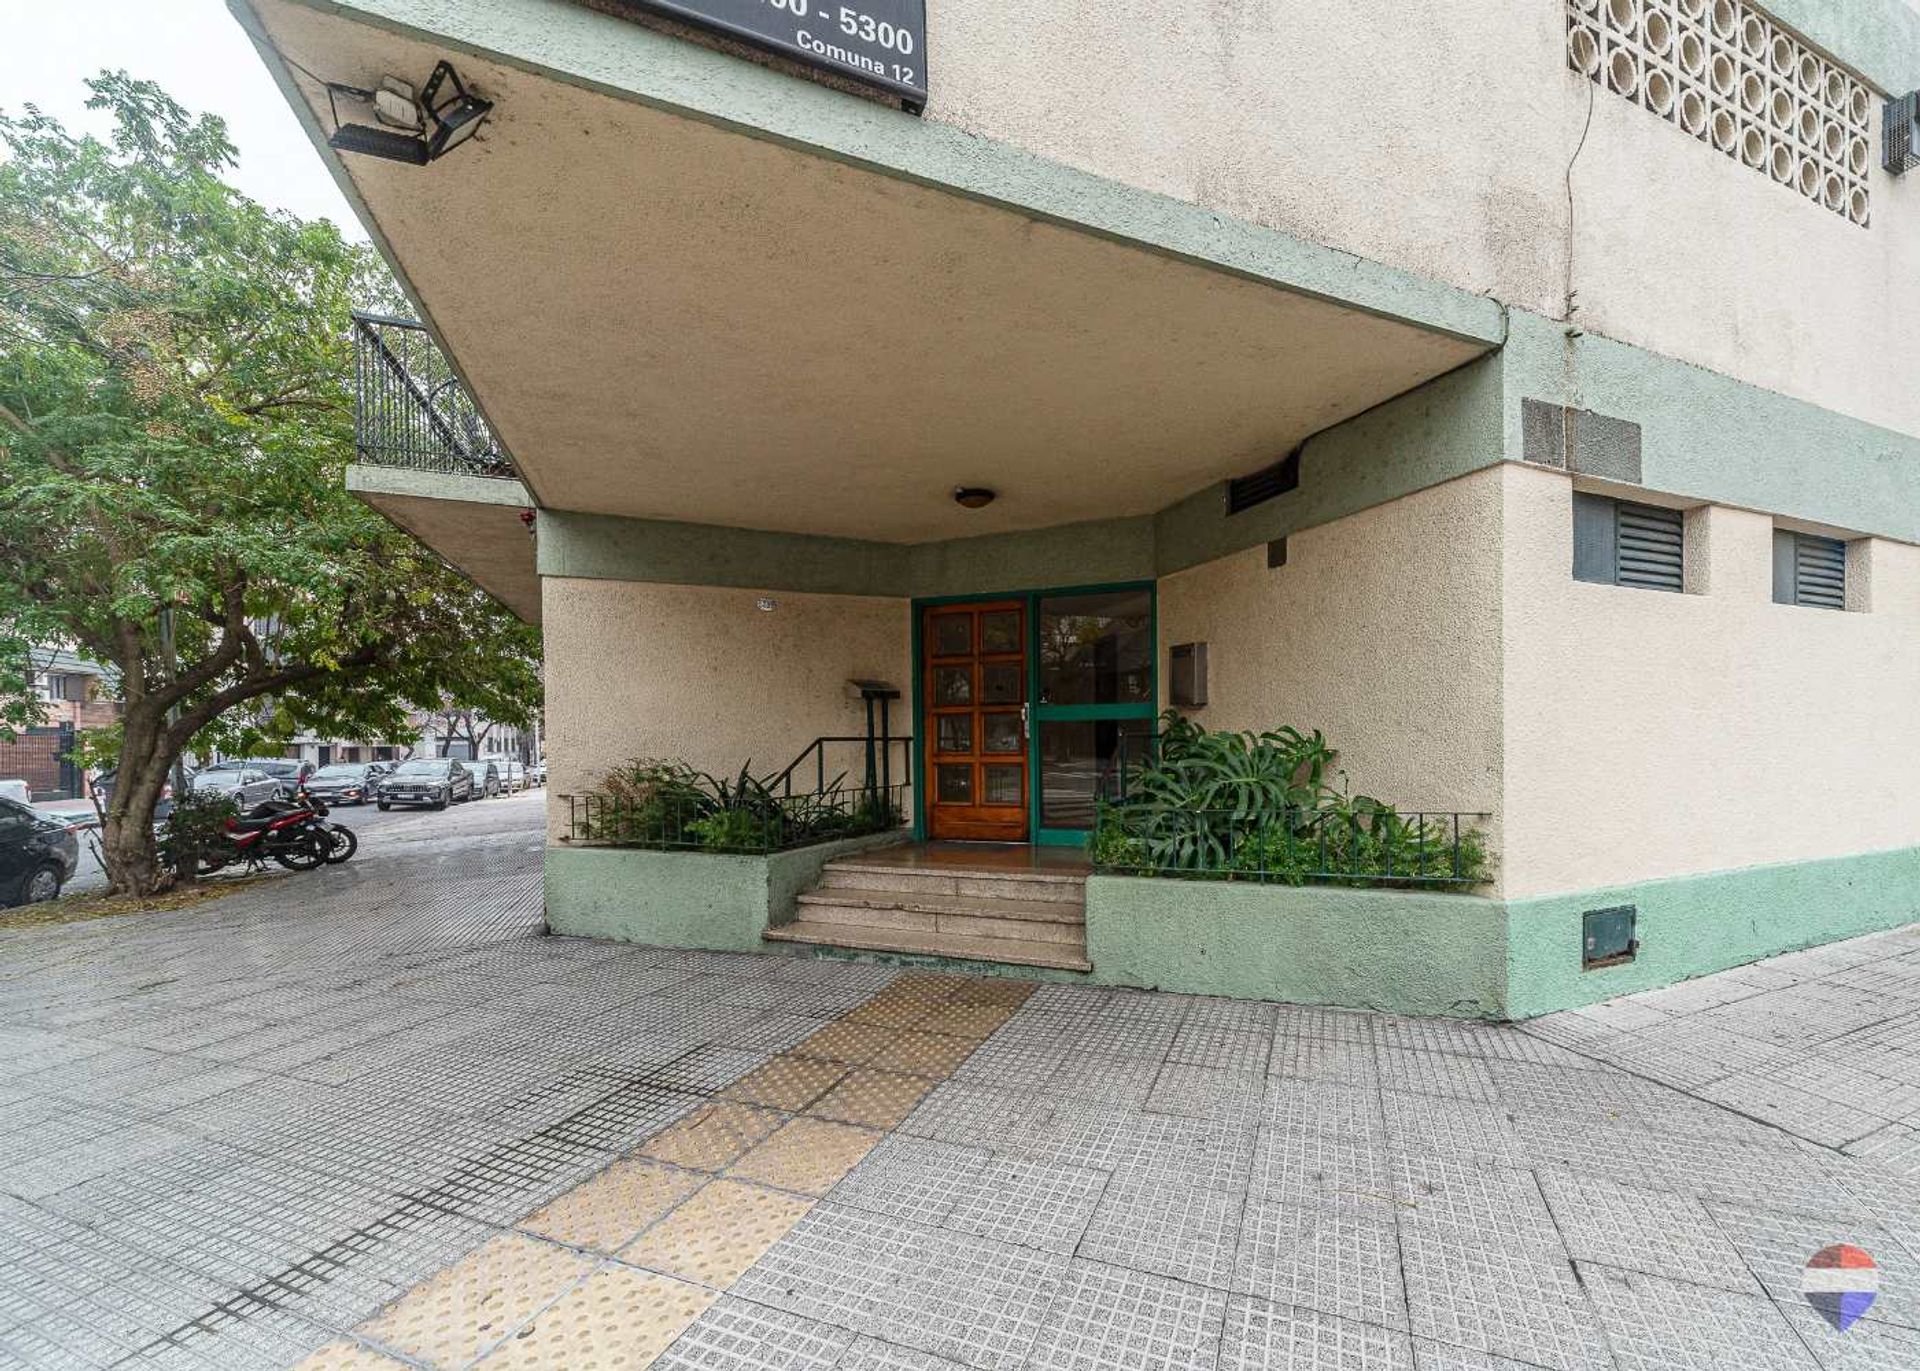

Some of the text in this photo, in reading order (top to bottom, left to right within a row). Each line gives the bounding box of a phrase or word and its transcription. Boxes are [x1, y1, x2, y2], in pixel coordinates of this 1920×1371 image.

[840, 6, 914, 54] 5300
[796, 30, 914, 85] Comuna 12
